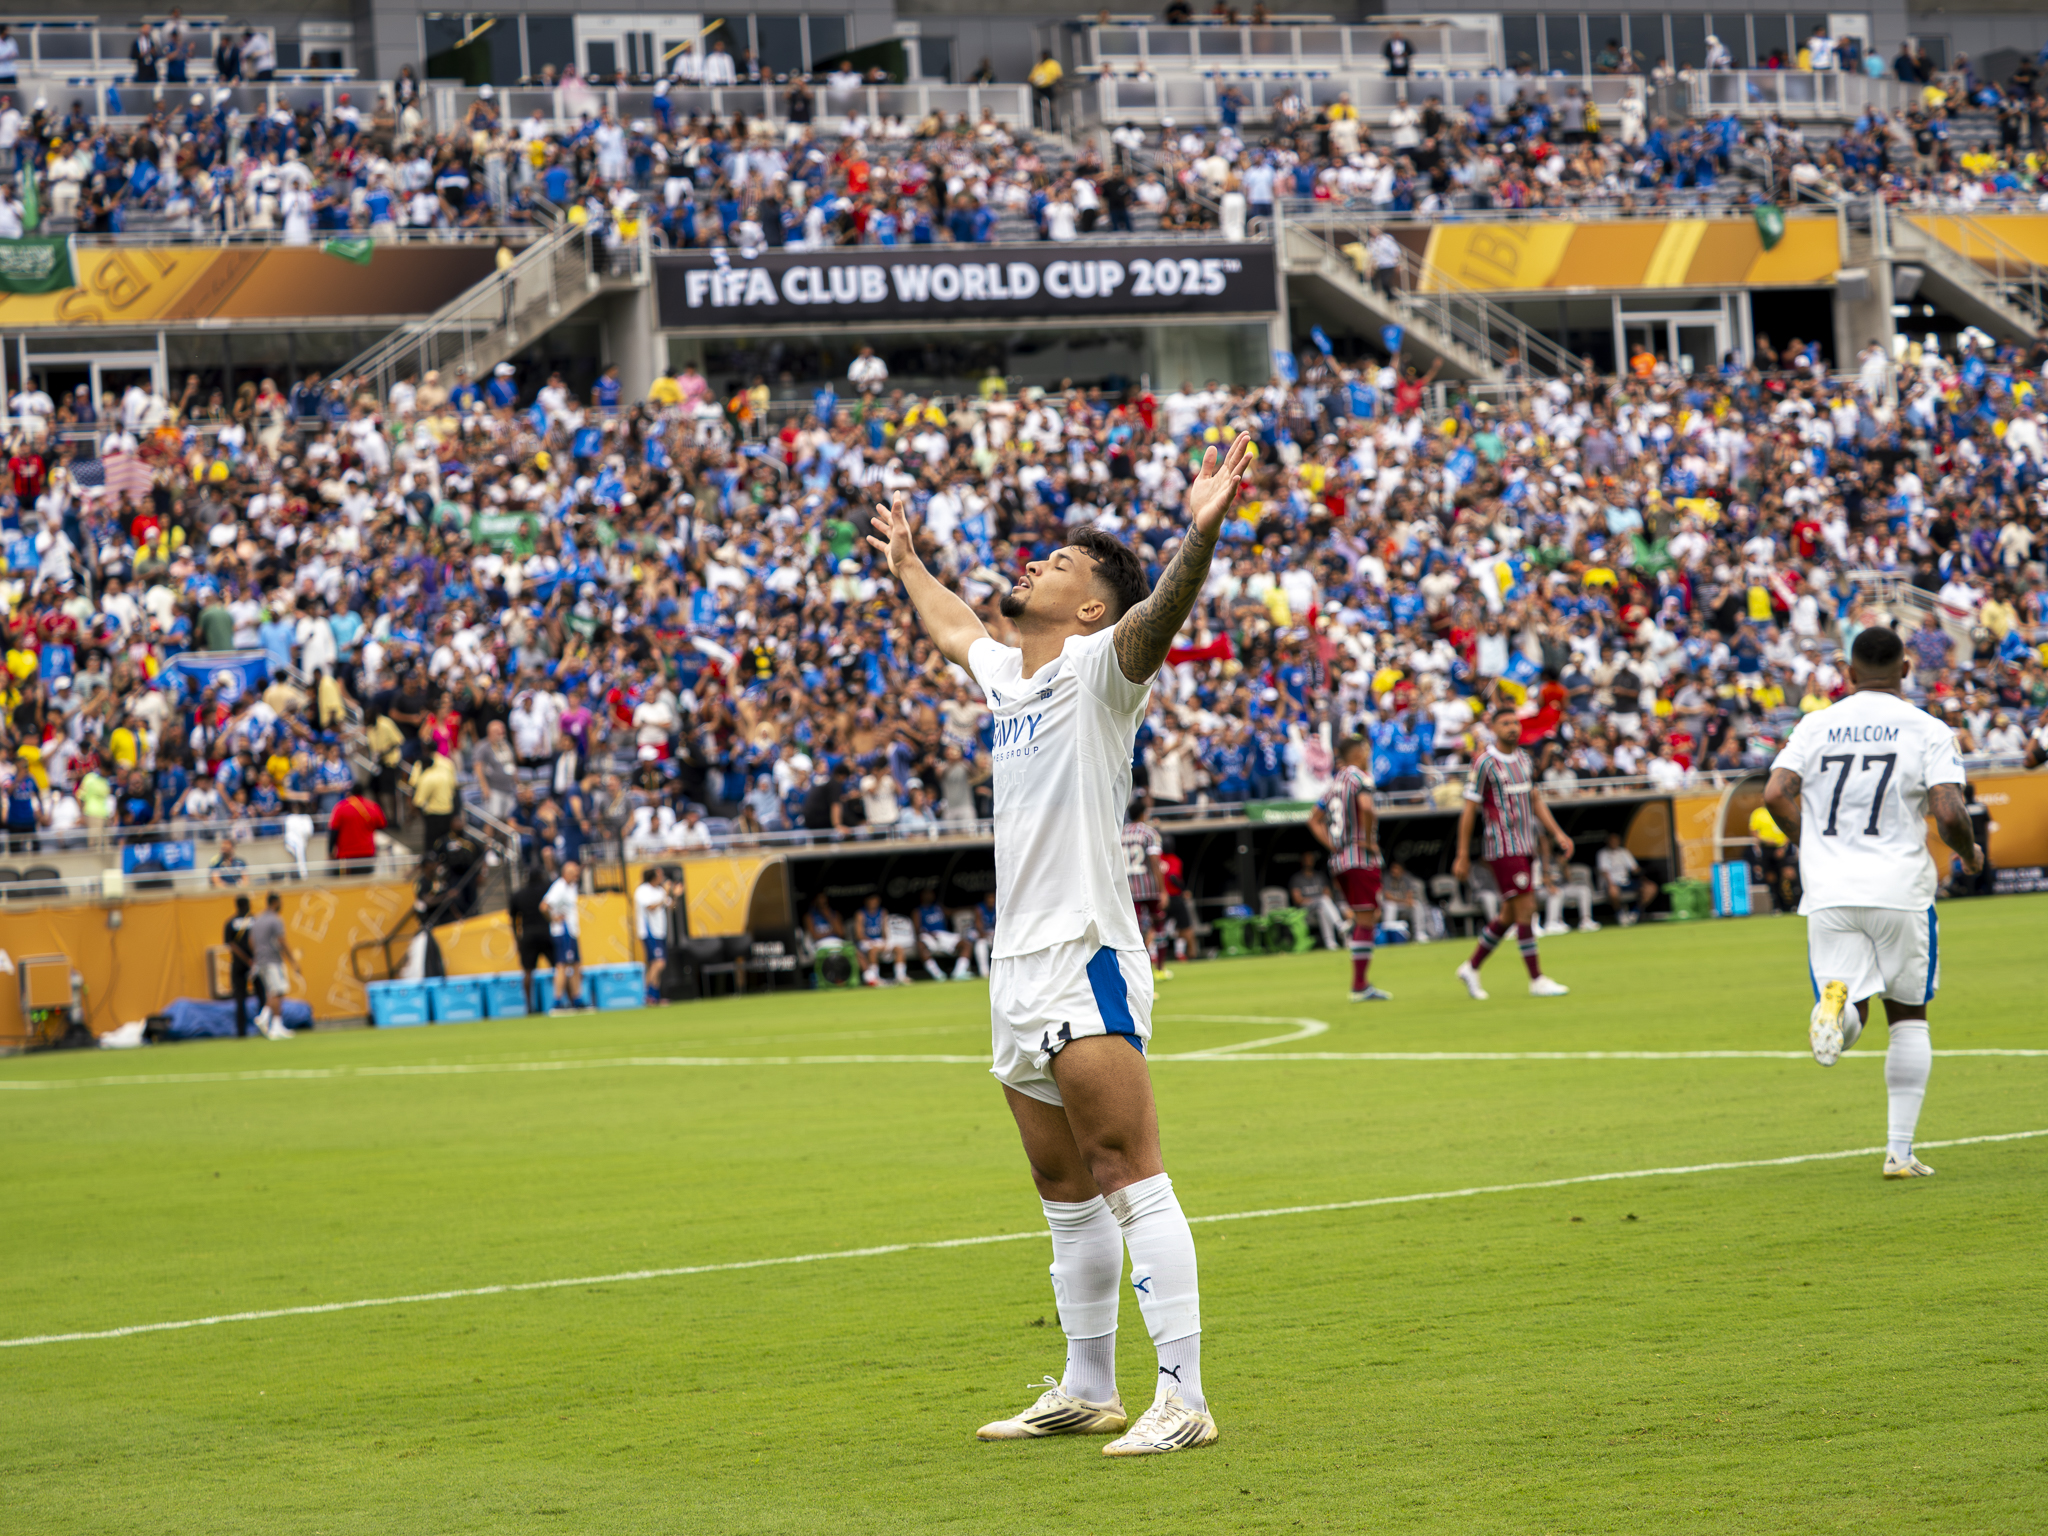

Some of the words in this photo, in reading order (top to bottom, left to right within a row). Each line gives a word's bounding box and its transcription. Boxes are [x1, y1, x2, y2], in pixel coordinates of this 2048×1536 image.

[685, 267, 779, 307] FIFA
[781, 265, 888, 304] CLUB
[891, 263, 1040, 302] WORLD
[1043, 259, 1126, 299] CUP
[1828, 725, 1899, 743] MALCOM
[1821, 753, 1898, 836] 77
